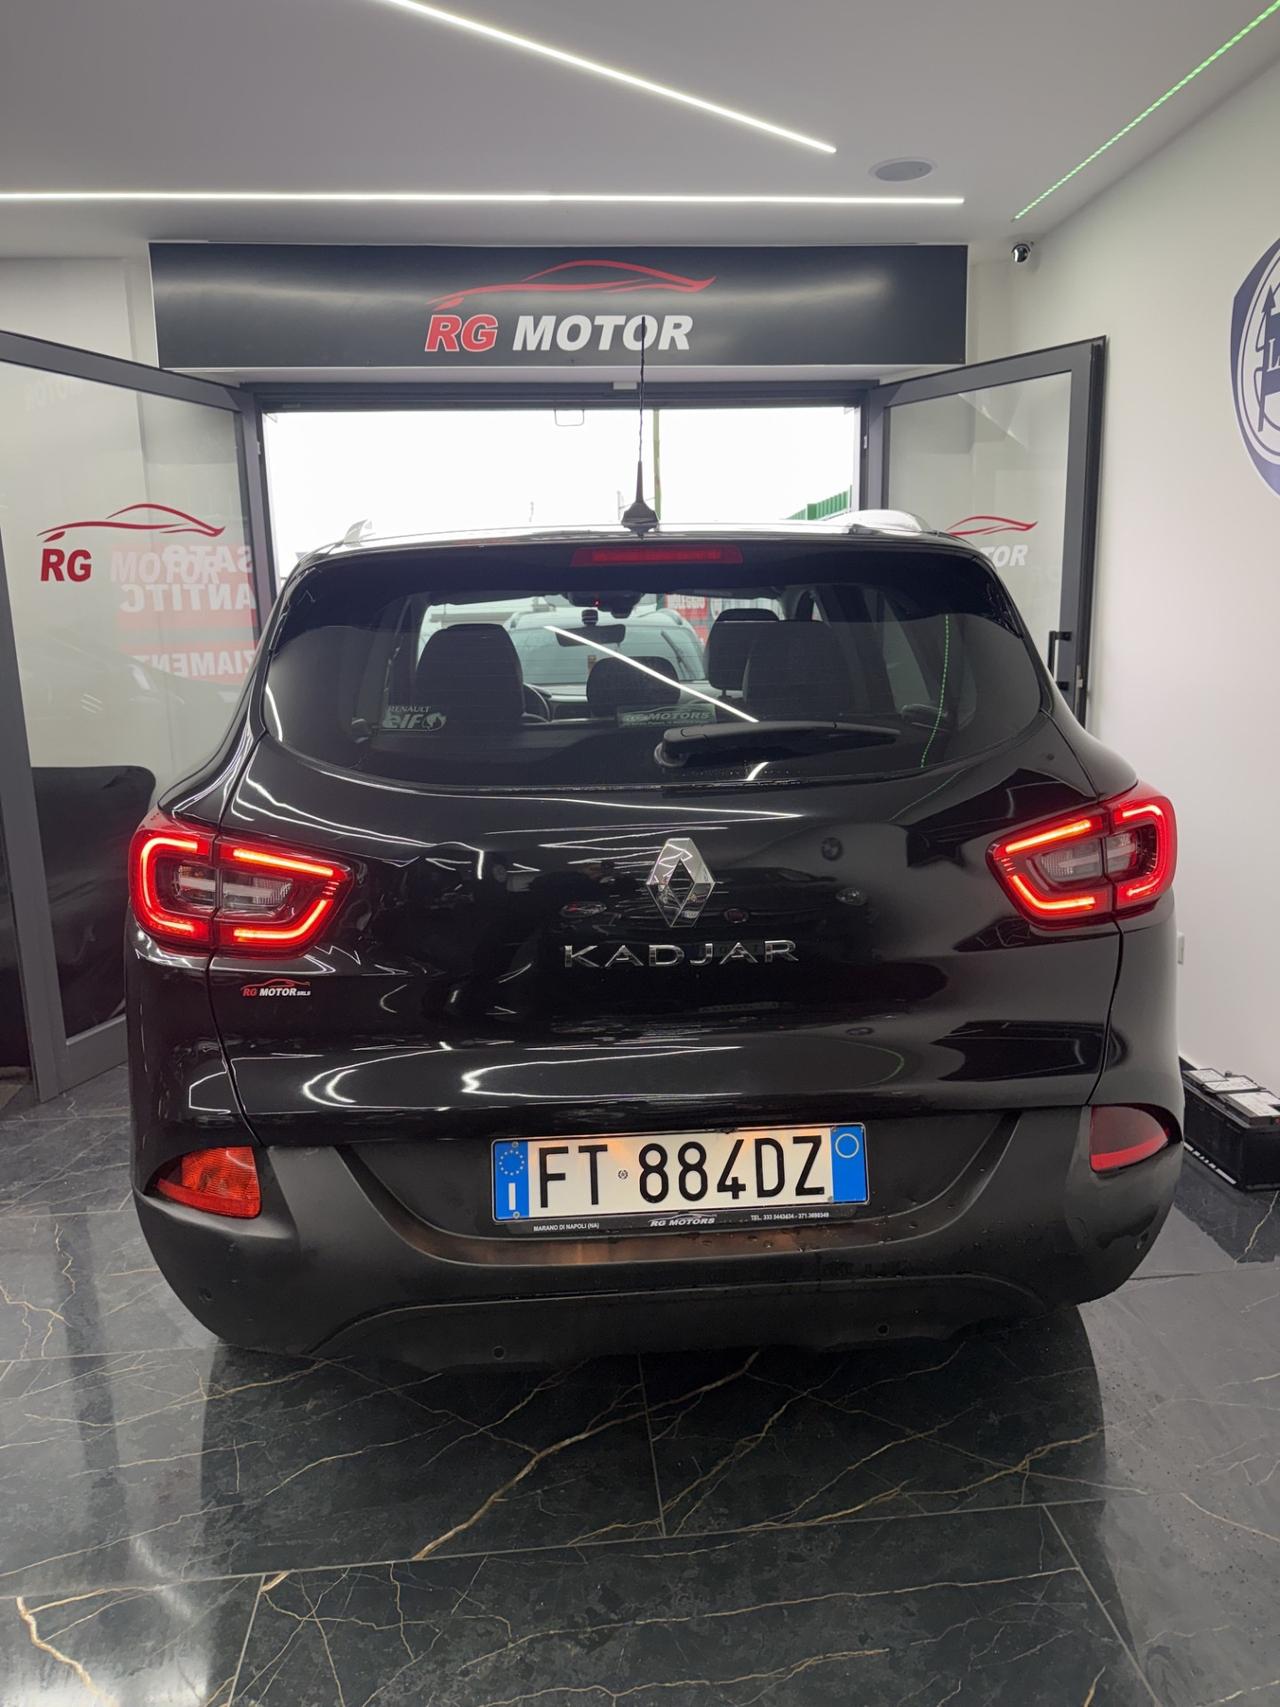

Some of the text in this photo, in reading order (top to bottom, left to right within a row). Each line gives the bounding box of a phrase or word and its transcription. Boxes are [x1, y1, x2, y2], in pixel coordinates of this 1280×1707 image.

[425, 314, 693, 352] RG MOTOR
[40, 548, 92, 582] RG
[387, 705, 431, 713] RENAULT
[646, 711, 710, 721] MOTORS
[564, 940, 799, 968] KADJAR
[243, 988, 257, 997] RG
[259, 987, 297, 996] MOTOR
[539, 1135, 825, 1208] FT 884DZ
[650, 1217, 715, 1227] RG MOTORS
